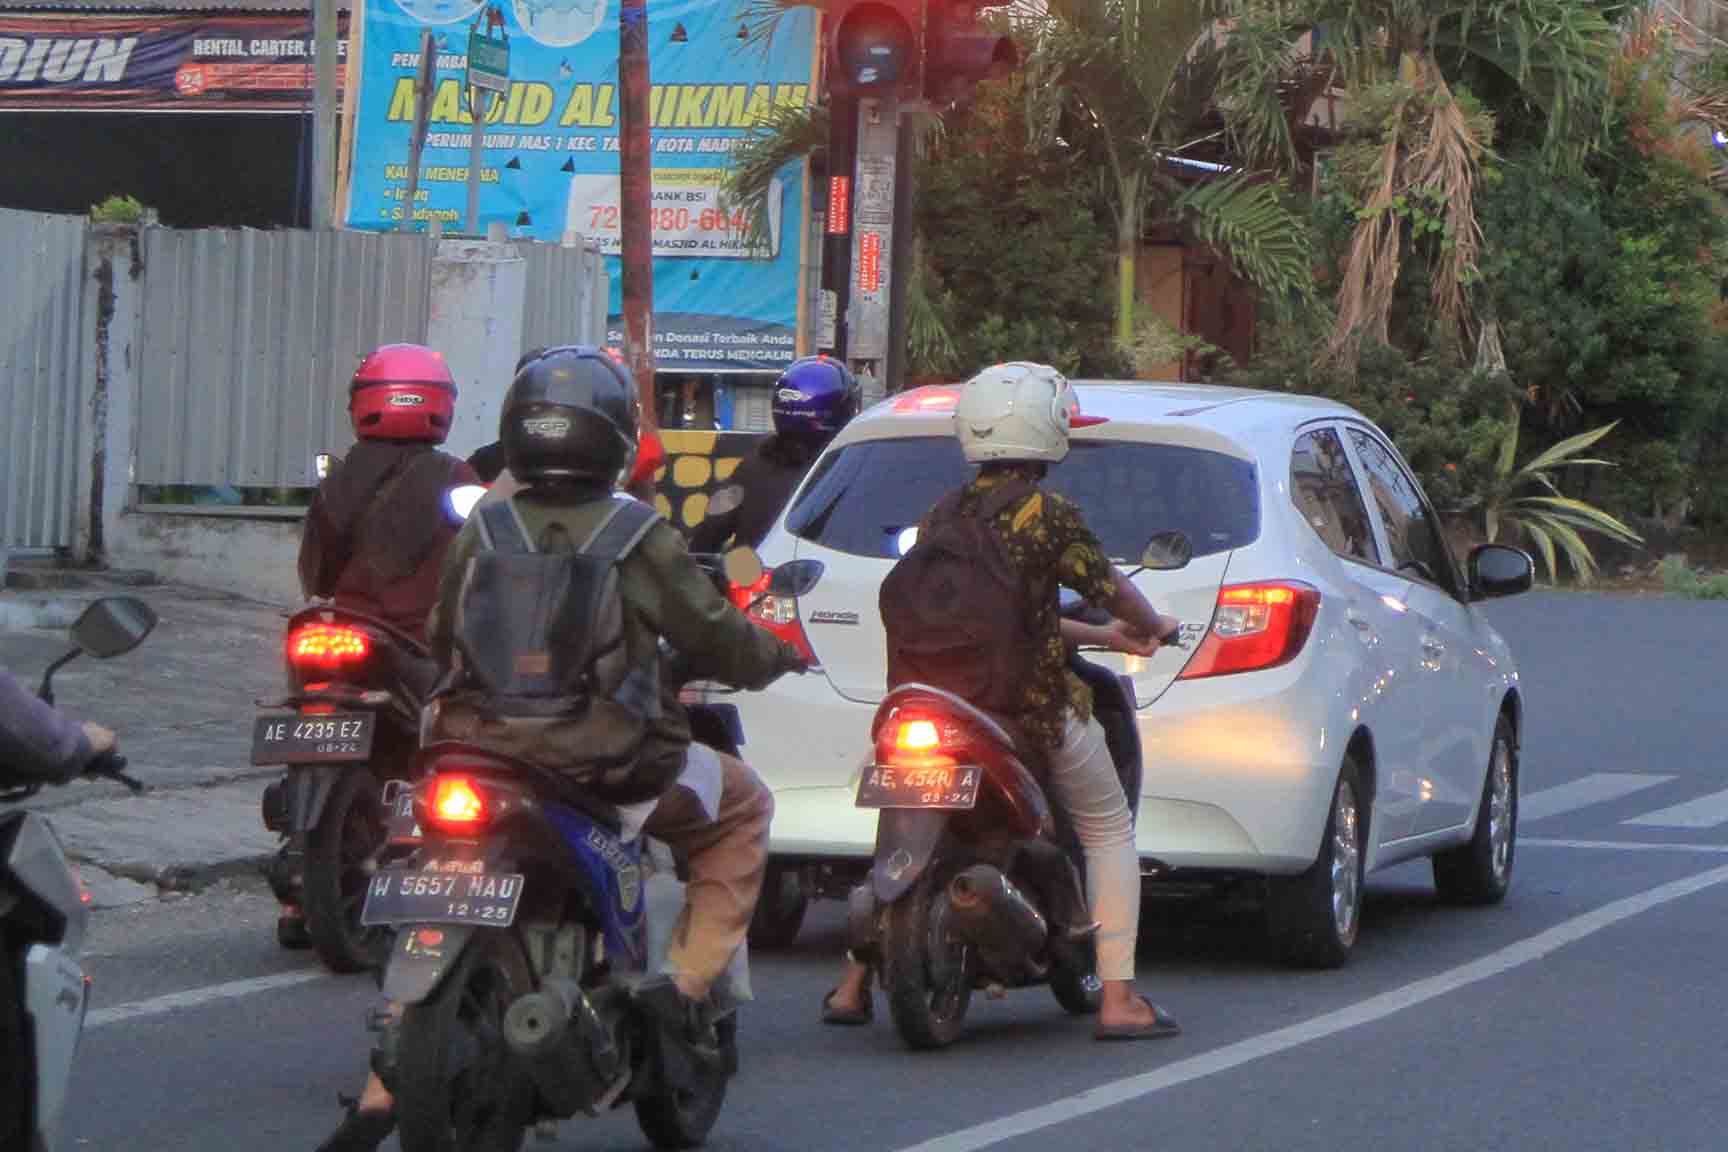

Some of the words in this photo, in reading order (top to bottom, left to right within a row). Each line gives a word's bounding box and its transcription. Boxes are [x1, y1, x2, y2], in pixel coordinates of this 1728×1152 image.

[193, 40, 248, 56] RENTAL,
[250, 40, 307, 57] CARTER,
[559, 84, 616, 127] AL
[656, 138, 693, 153] KOTA
[265, 724, 286, 741] AE
[293, 722, 336, 740] 4235
[340, 721, 363, 738] EZ
[400, 876, 455, 896] 5657
